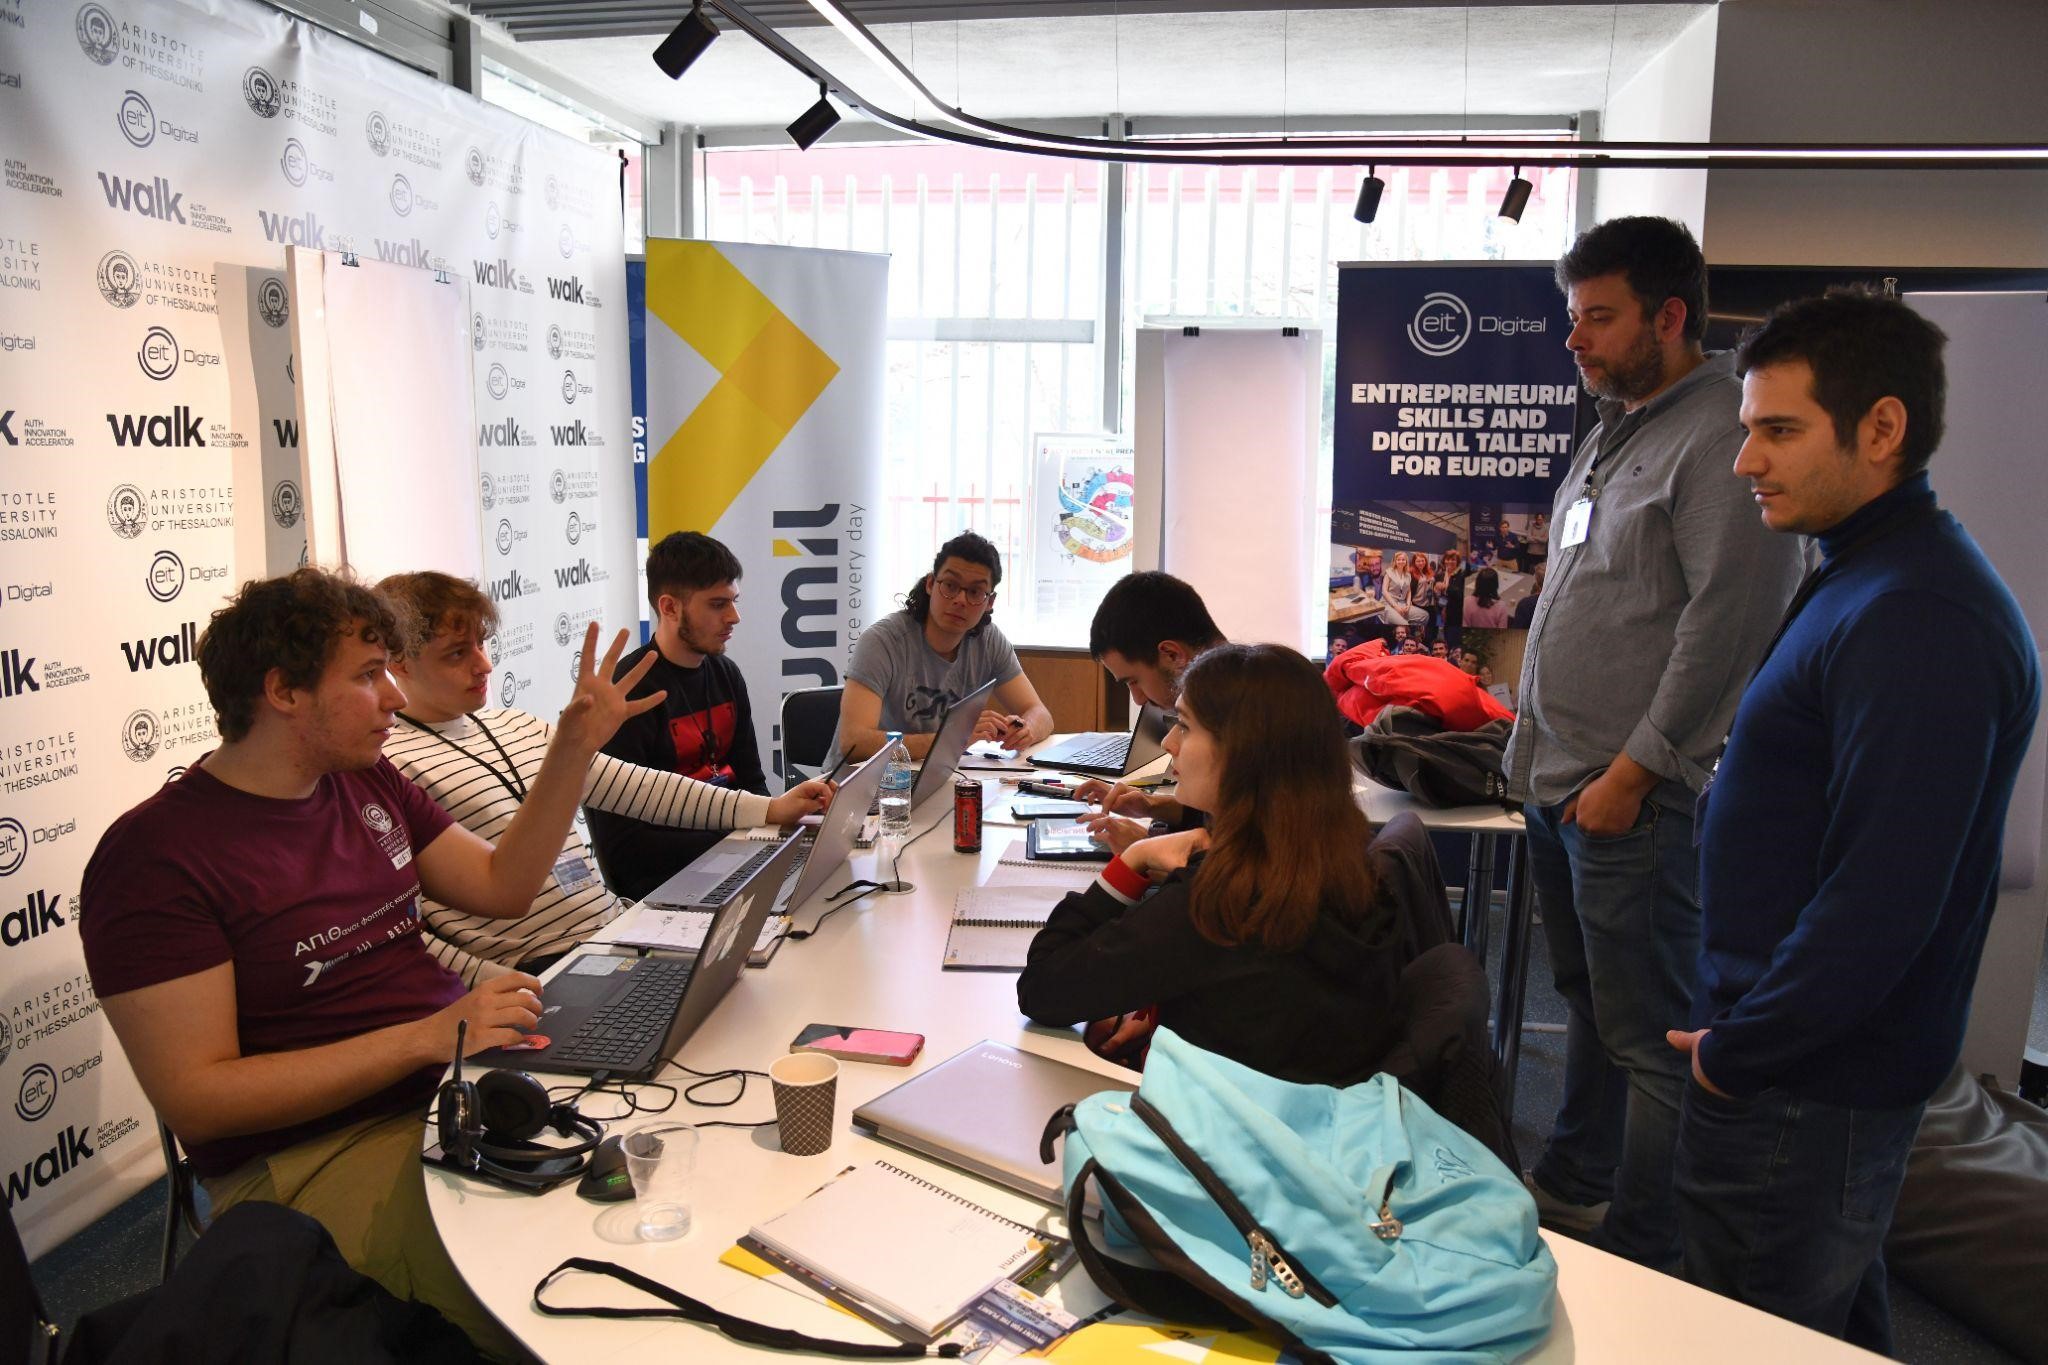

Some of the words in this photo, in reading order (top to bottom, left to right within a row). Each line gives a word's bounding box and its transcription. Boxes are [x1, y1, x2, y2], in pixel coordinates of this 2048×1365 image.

[121, 21, 204, 61] ARISTOTLE
[122, 37, 203, 77] UNIVERSITY
[126, 109, 147, 129] eit
[160, 122, 199, 143] Digital
[4, 159, 26, 171] AUTH
[5, 169, 54, 185] INNOVATION
[6, 179, 63, 198] ACCELERATOR
[98, 171, 186, 224] walk
[259, 210, 326, 250] walk
[374, 238, 431, 270] walk
[144, 262, 216, 284] ARISTOTLE
[473, 259, 517, 290] walk
[145, 279, 217, 298] UNIVERSITY
[548, 276, 584, 305] walk
[1423, 313, 1455, 332] eit
[1479, 317, 1546, 336] Digital
[148, 345, 169, 361] eit
[184, 349, 220, 366] Digital
[24, 419, 44, 427] AUTH
[107, 406, 205, 447] walk
[1398, 408, 1484, 428] SKILLS
[1490, 410, 1546, 429] AND
[25, 429, 66, 437] INNOVATION
[26, 438, 74, 446] ACCELERATOR
[479, 417, 519, 446] walk
[551, 420, 586, 446] walk
[1372, 432, 1469, 452] DIGITAL
[1476, 433, 1571, 453] TALENT
[1391, 456, 1440, 476] FOR
[1447, 457, 1550, 477] EUROPE
[151, 488, 233, 499] ARISTOTLE
[152, 503, 233, 515] UNIVERSITY
[846, 503, 867, 541] day
[155, 567, 175, 583] eit
[190, 566, 227, 581] Digital
[555, 558, 590, 588] walk
[848, 550, 866, 609] every
[8, 583, 52, 601] Digital
[488, 570, 522, 602] walk
[165, 738, 177, 750] OF
[4, 764, 78, 793] THESSALONIKI
[33, 818, 76, 844] Digital
[387, 917, 412, 939] BETA
[18, 1034, 31, 1049] OF
[981, 1051, 1022, 1069] Lenovo
[25, 1079, 48, 1102] eit
[63, 1051, 103, 1083] Digital
[1, 1124, 94, 1208] walk
